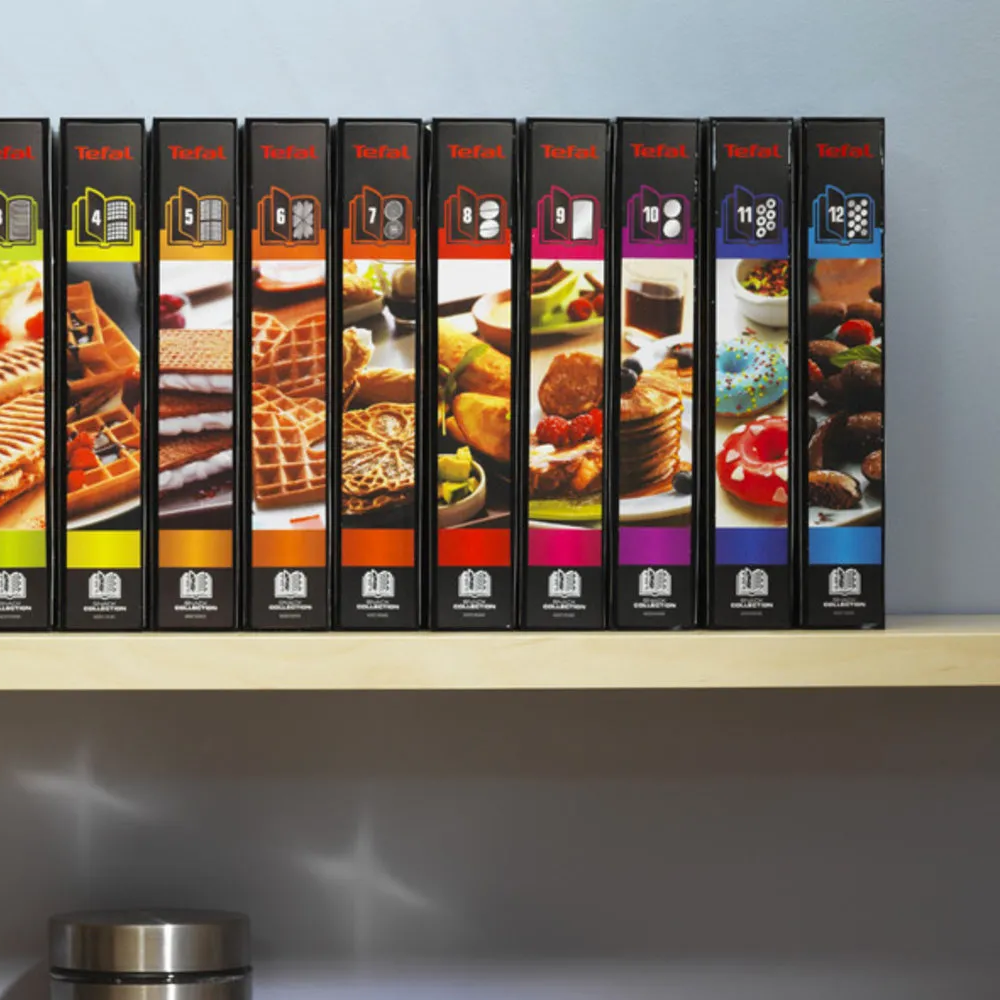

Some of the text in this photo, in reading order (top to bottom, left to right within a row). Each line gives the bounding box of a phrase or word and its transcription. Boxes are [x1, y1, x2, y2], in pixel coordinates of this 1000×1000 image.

[74, 145, 134, 160] Tefal
[167, 144, 227, 160] Tefal
[259, 144, 319, 160] Tefal
[353, 143, 412, 159] Tefal
[447, 143, 506, 159] Tefal
[540, 143, 599, 159] Tefal
[630, 142, 689, 159] Tefal
[723, 143, 782, 158] Tefal
[815, 143, 874, 158] Tefal
[91, 209, 102, 227] 4
[184, 207, 194, 226] 5
[276, 207, 286, 225] 6
[368, 206, 377, 224] 7
[462, 206, 473, 225] 8
[555, 206, 566, 225] 9
[642, 205, 659, 223] 10
[737, 206, 752, 223] 11
[828, 205, 845, 223] 12
